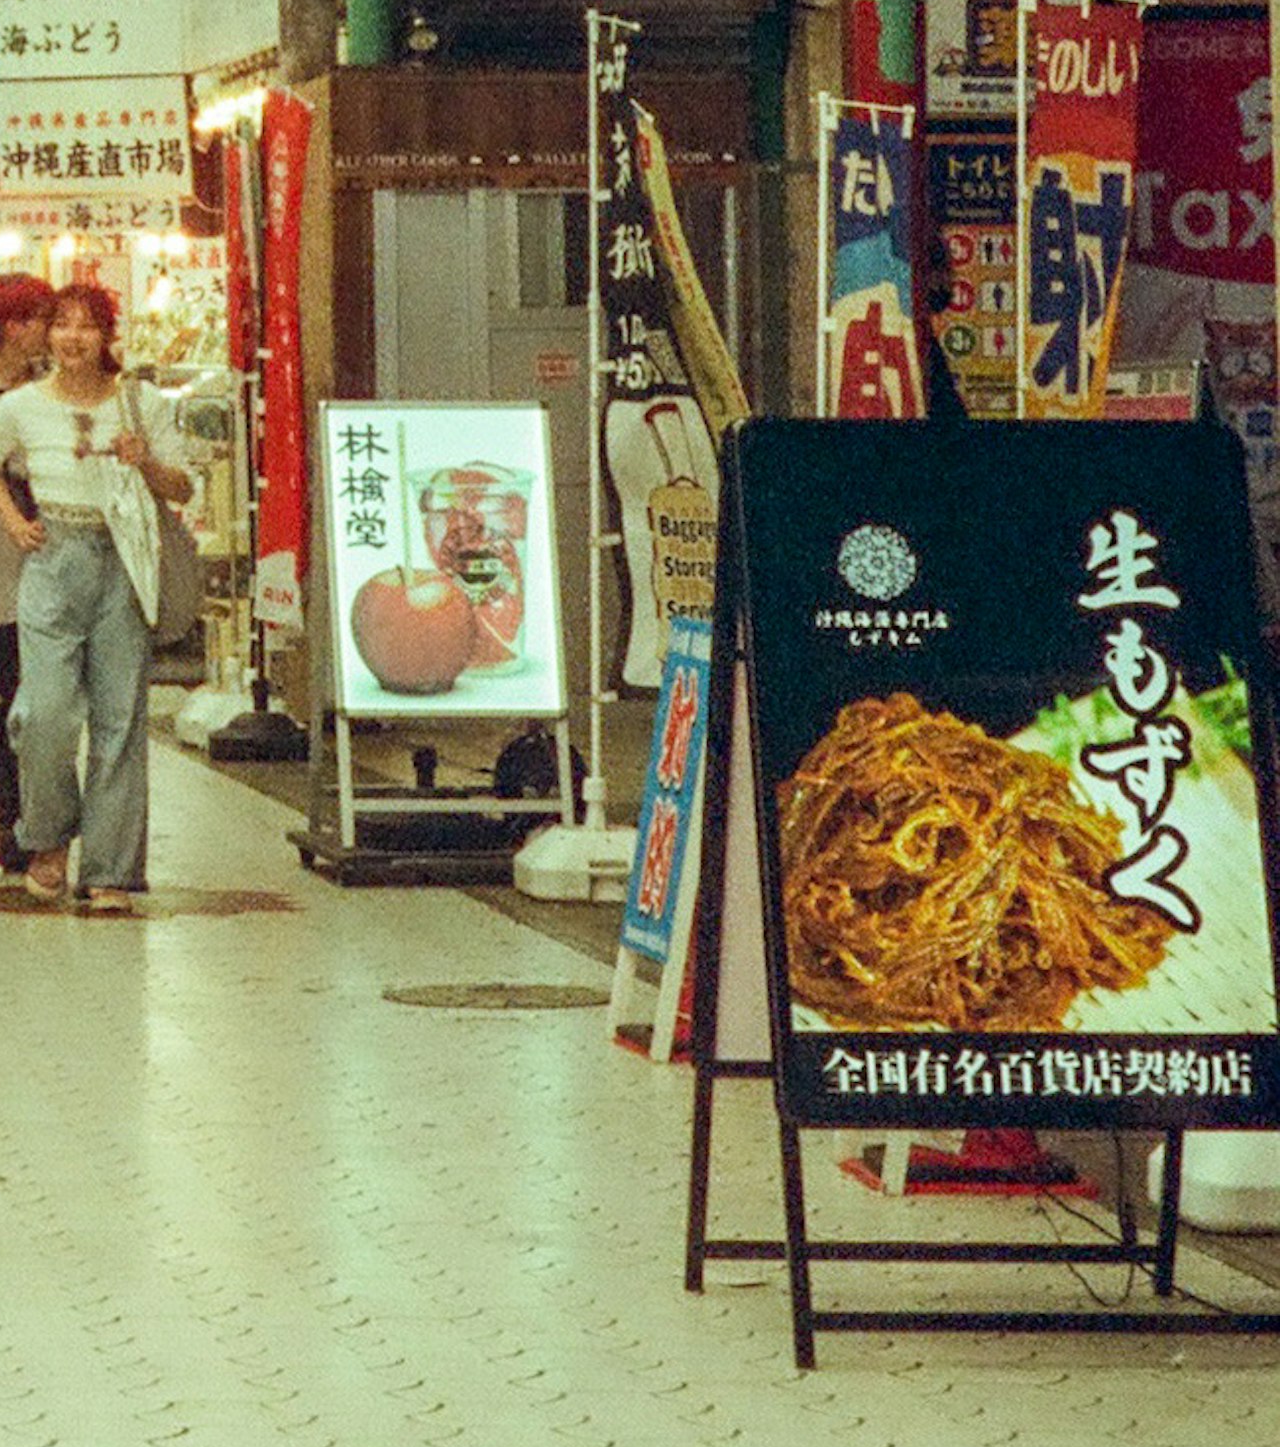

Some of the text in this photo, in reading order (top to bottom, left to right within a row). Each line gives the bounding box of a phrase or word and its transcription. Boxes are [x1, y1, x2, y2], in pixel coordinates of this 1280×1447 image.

[0, 20, 121, 55] 海ぶどう
[2, 137, 186, 180] 沖縄産直市場
[1077, 509, 1195, 928] 生もずく
[822, 1047, 1253, 1097] 全国有名百貨店契約店
